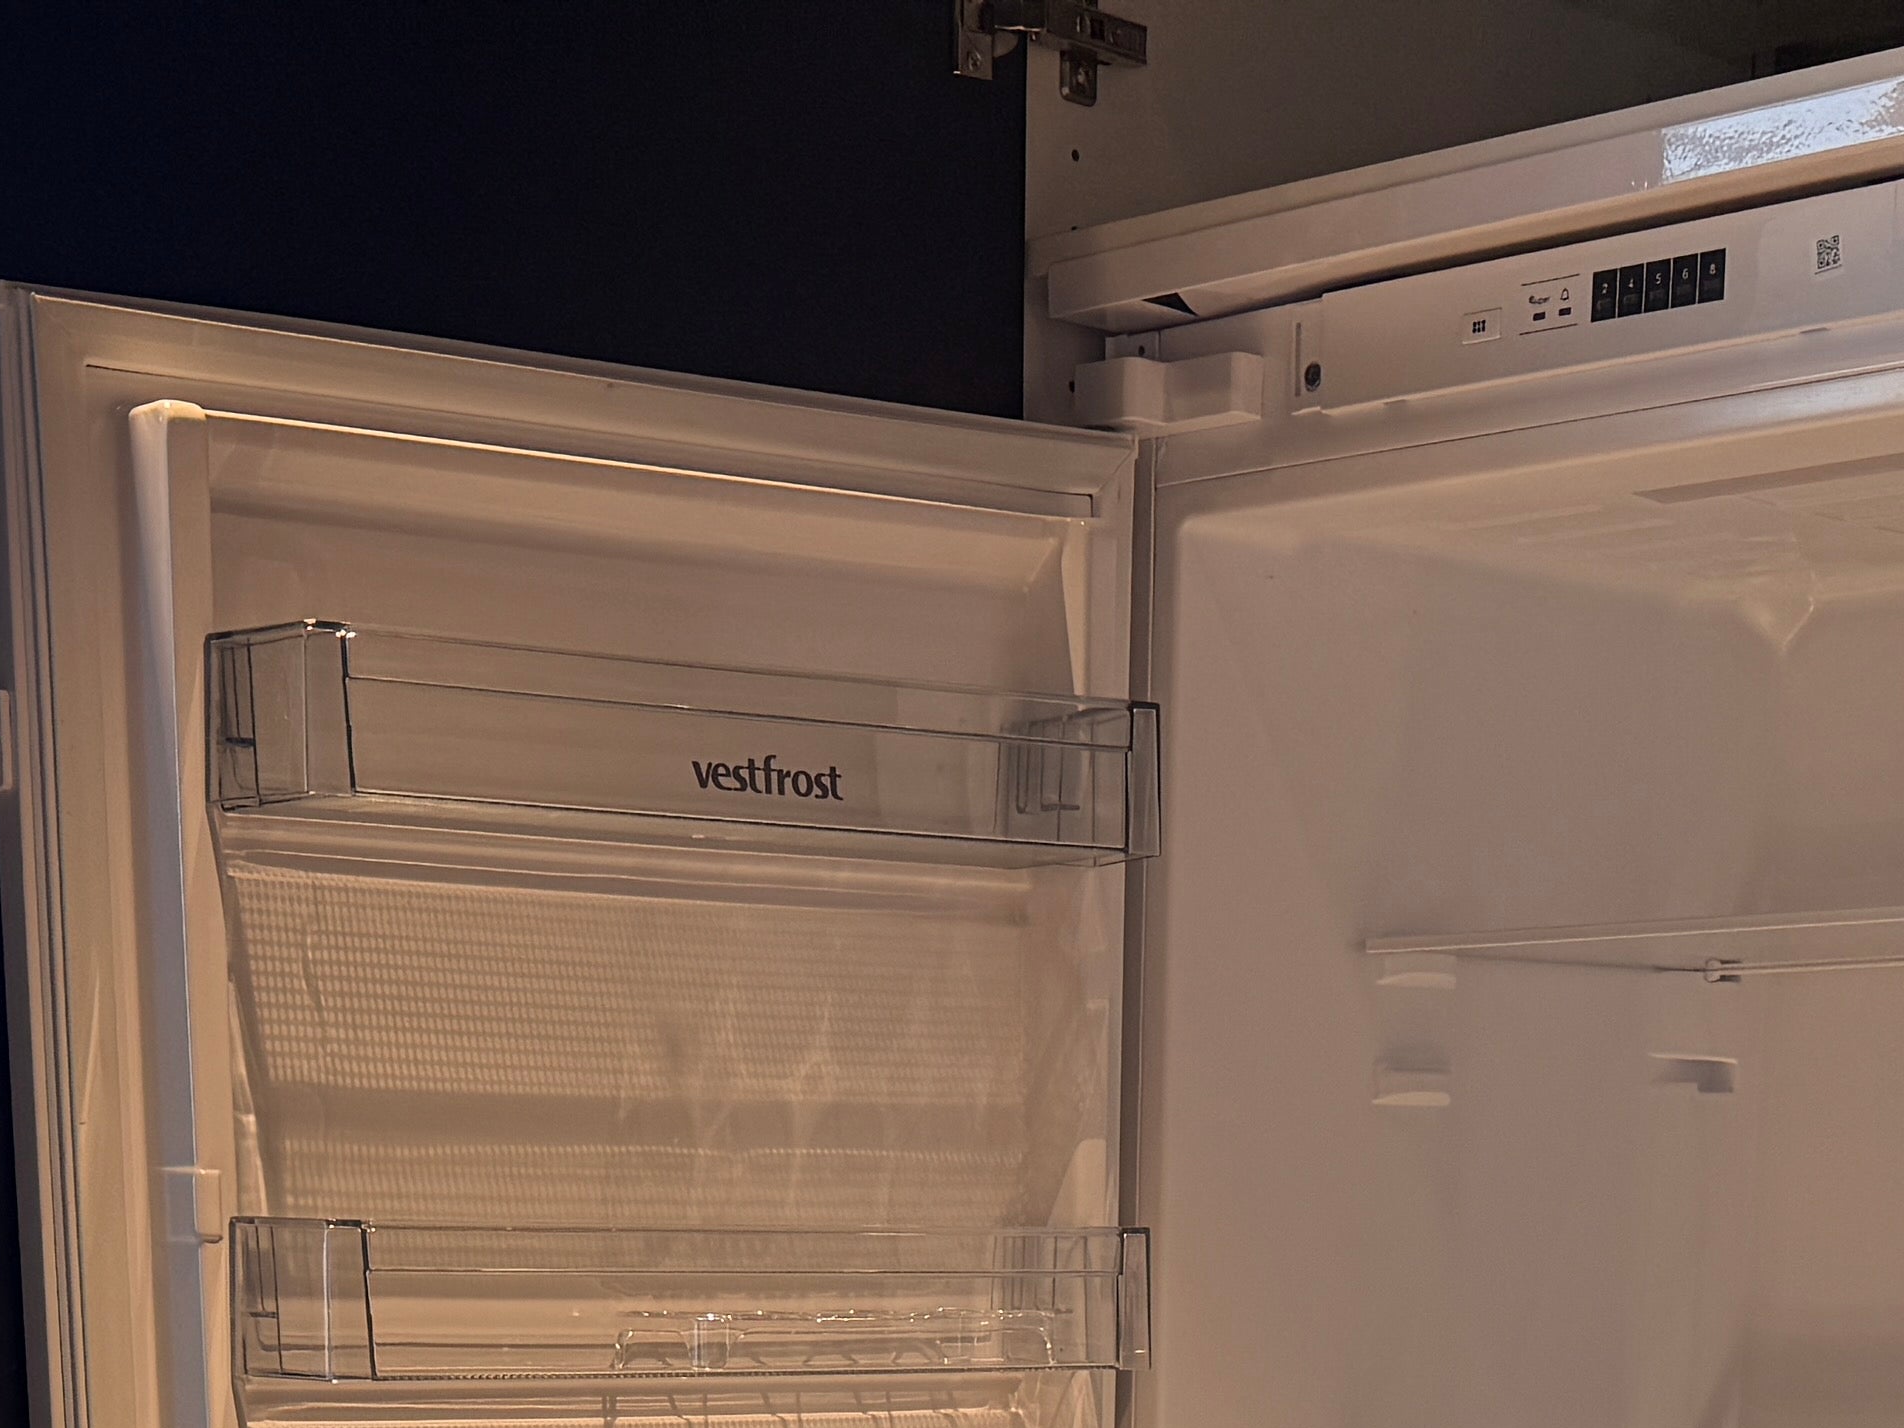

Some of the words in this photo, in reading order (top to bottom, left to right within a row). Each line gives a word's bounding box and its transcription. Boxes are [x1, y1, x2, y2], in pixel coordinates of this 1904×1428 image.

[1655, 273, 1662, 285] 5
[1682, 268, 1689, 280] 6
[1709, 263, 1716, 275] 8
[691, 754, 844, 801] vestfrost
